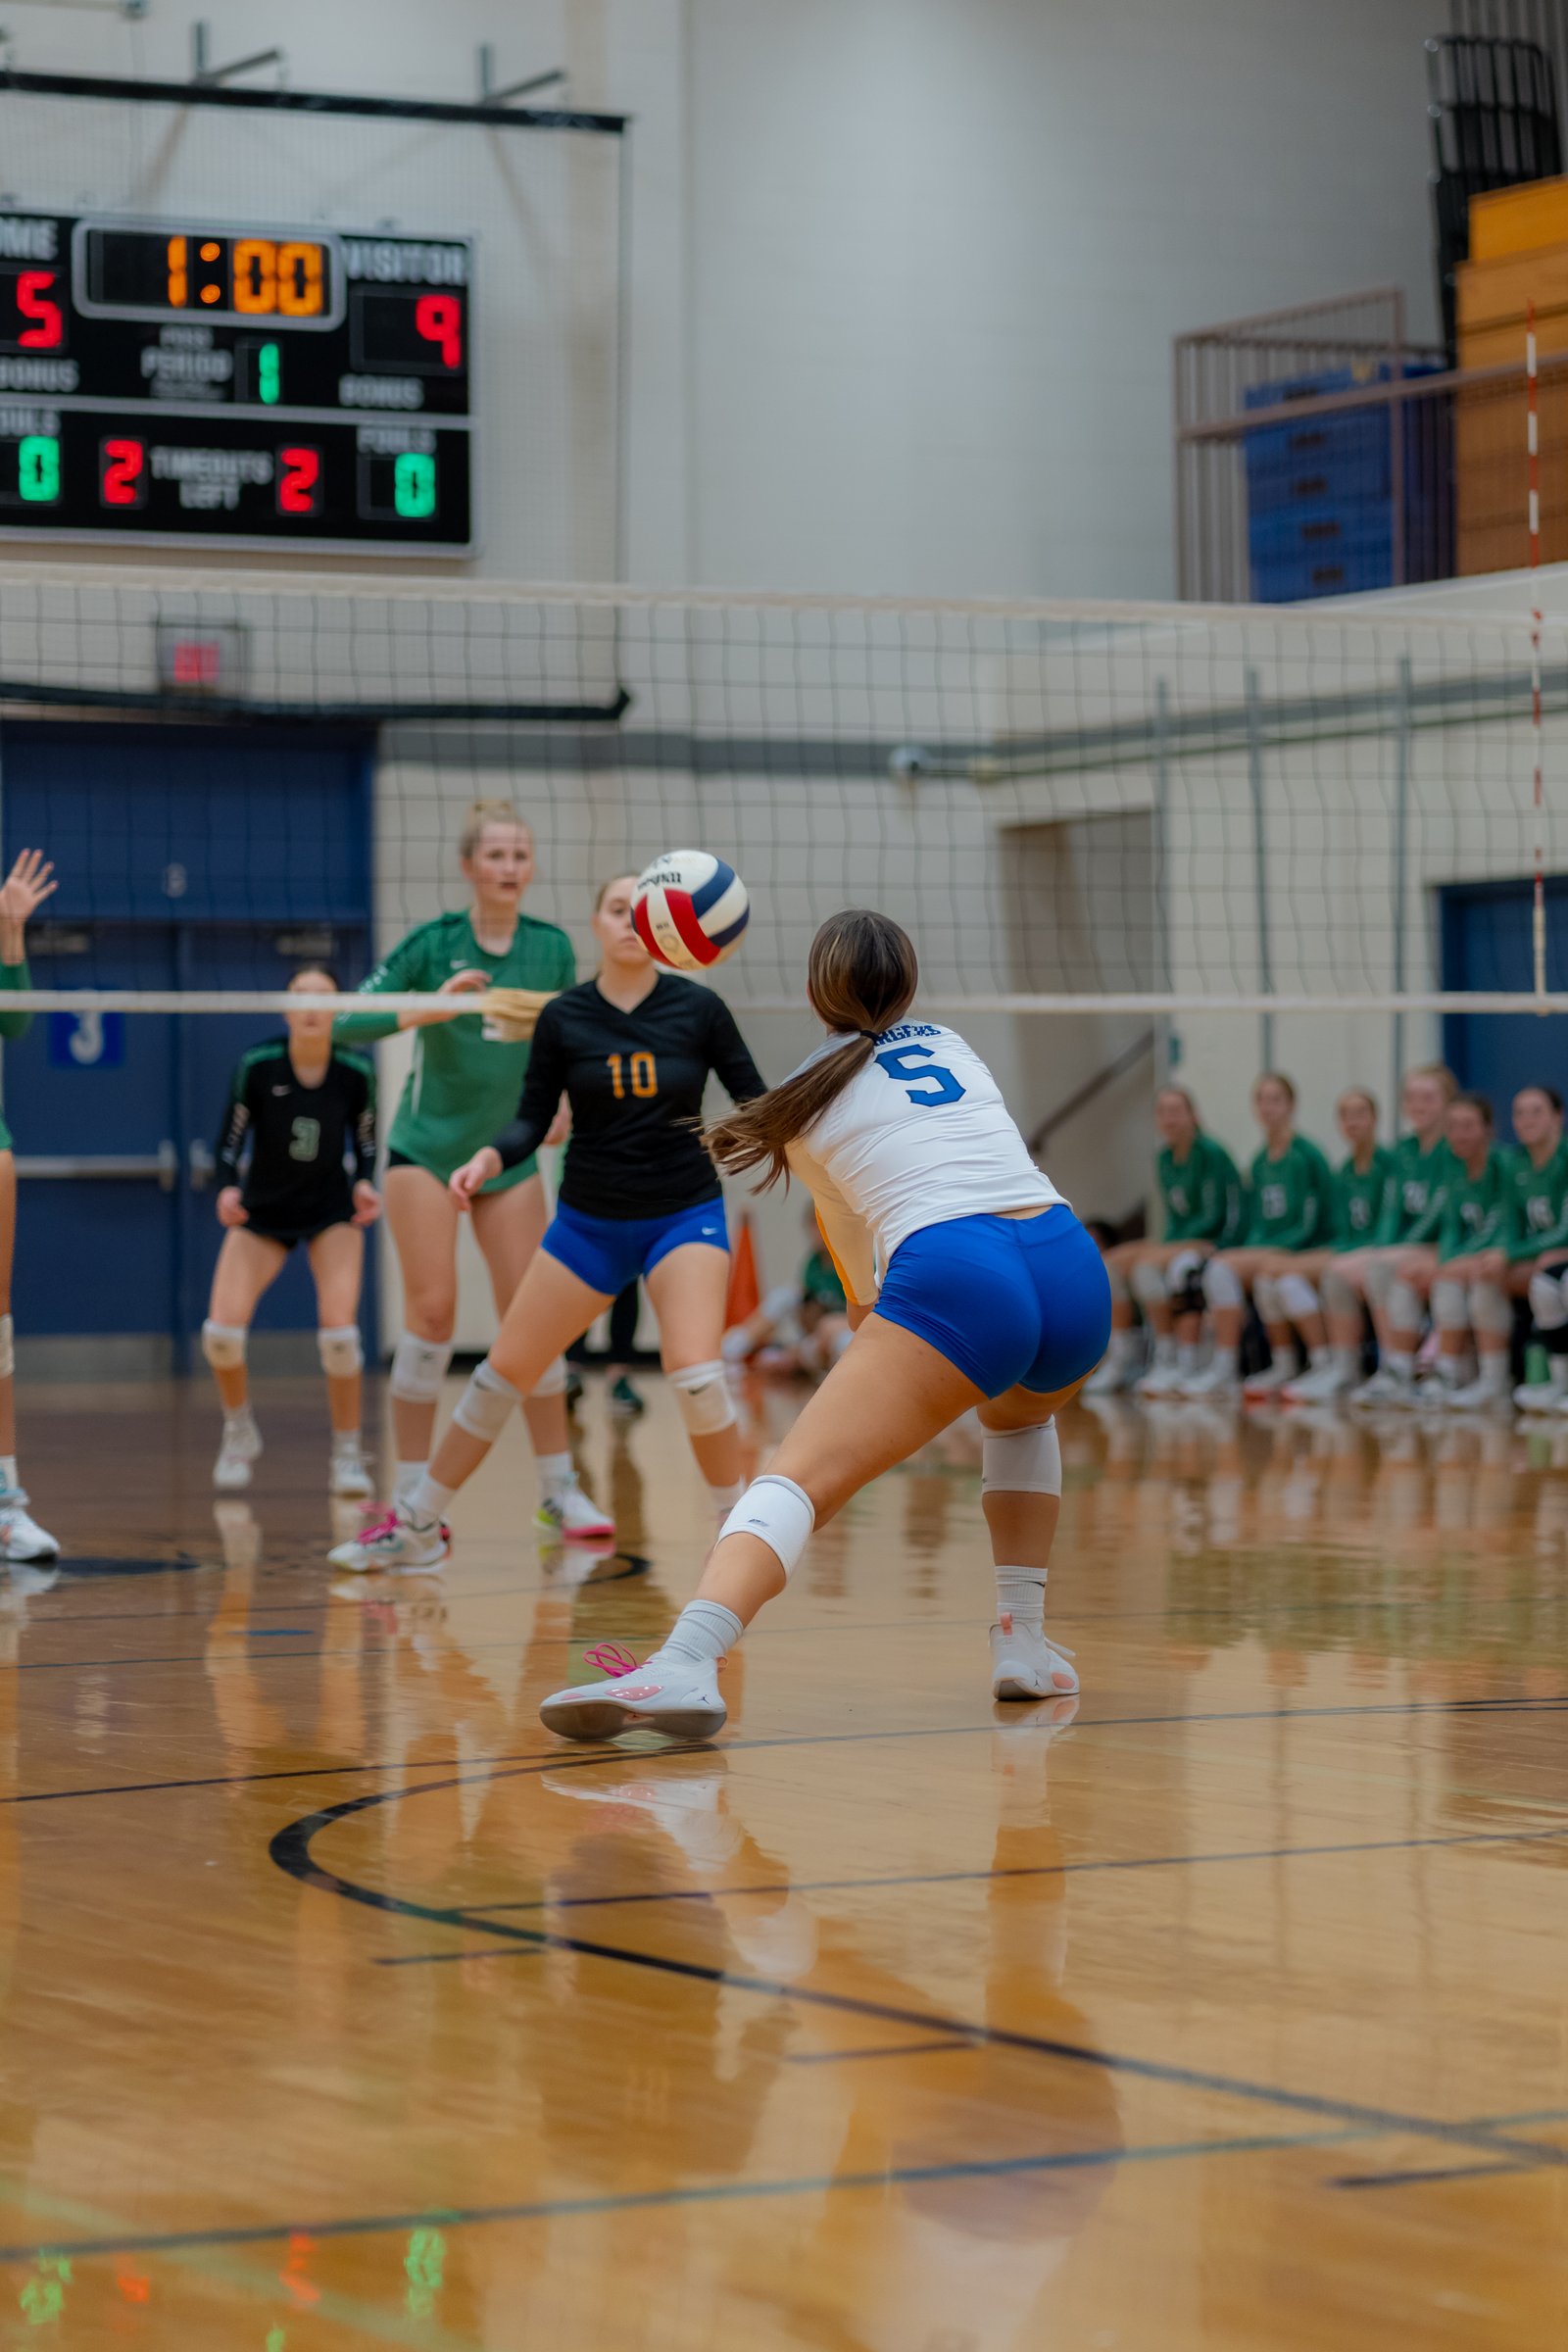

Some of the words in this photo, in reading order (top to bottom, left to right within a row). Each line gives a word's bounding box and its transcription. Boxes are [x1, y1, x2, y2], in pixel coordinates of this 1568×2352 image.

[167, 235, 323, 317] 1:00
[344, 239, 468, 285] VISITOR
[16, 270, 63, 348] 5
[416, 294, 461, 368] 9
[259, 343, 280, 404] 1
[19, 435, 60, 502] 0
[104, 440, 143, 504] 2
[150, 446, 273, 484] TIMEOUTS
[279, 448, 318, 512] 2
[394, 453, 436, 517] 0
[873, 1024, 942, 1047] RGERS
[606, 1051, 659, 1099] 10
[874, 1044, 966, 1107] 5
